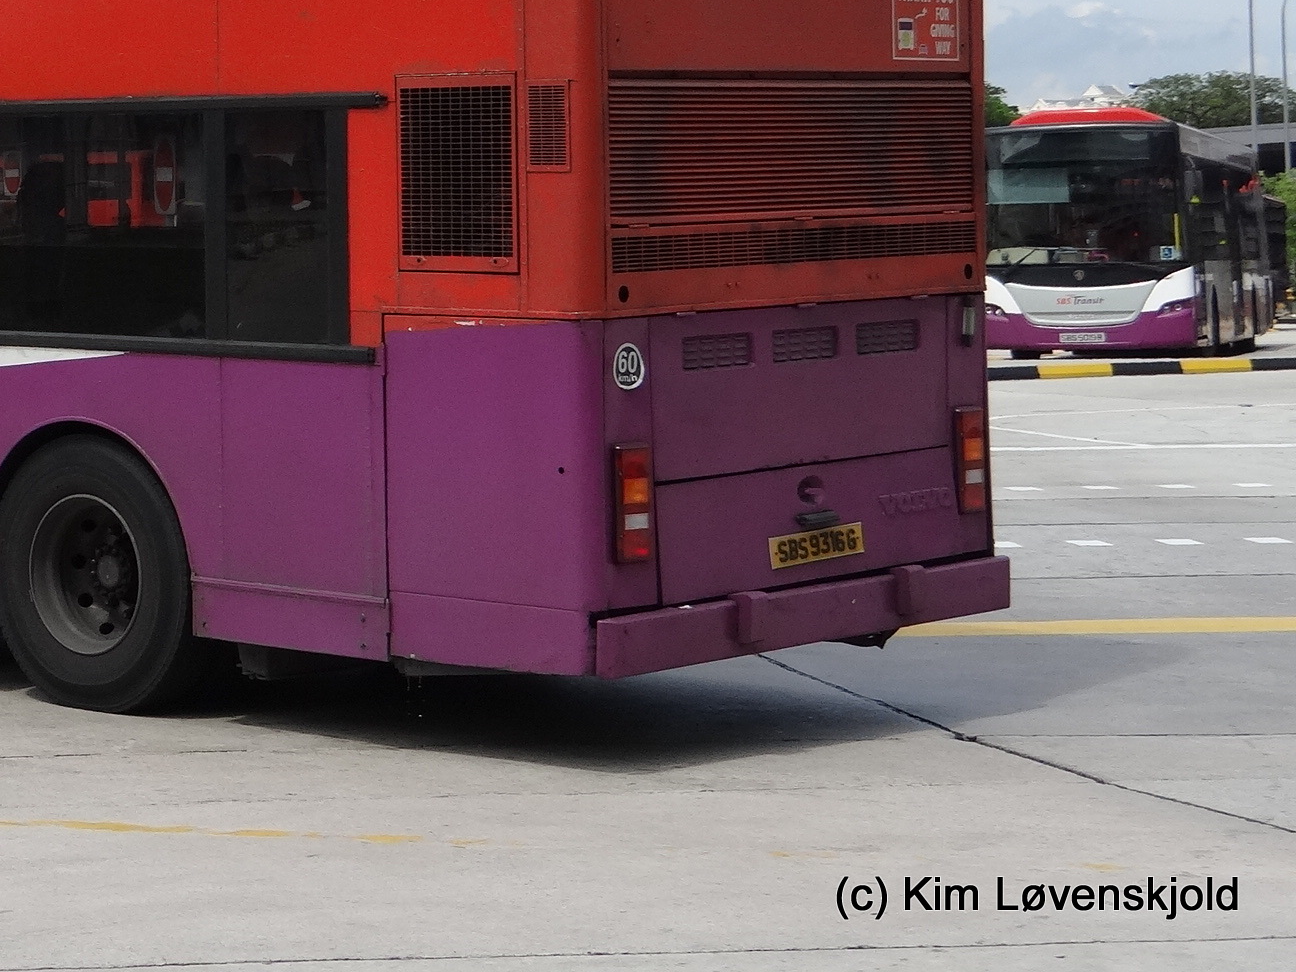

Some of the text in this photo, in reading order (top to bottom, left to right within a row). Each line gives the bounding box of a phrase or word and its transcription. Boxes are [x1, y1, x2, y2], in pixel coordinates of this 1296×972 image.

[935, 7, 950, 21] FOR
[935, 41, 951, 55] WAY
[1055, 297, 1071, 305] SBS
[618, 351, 638, 373] 60
[777, 529, 858, 563] SBS9316G
